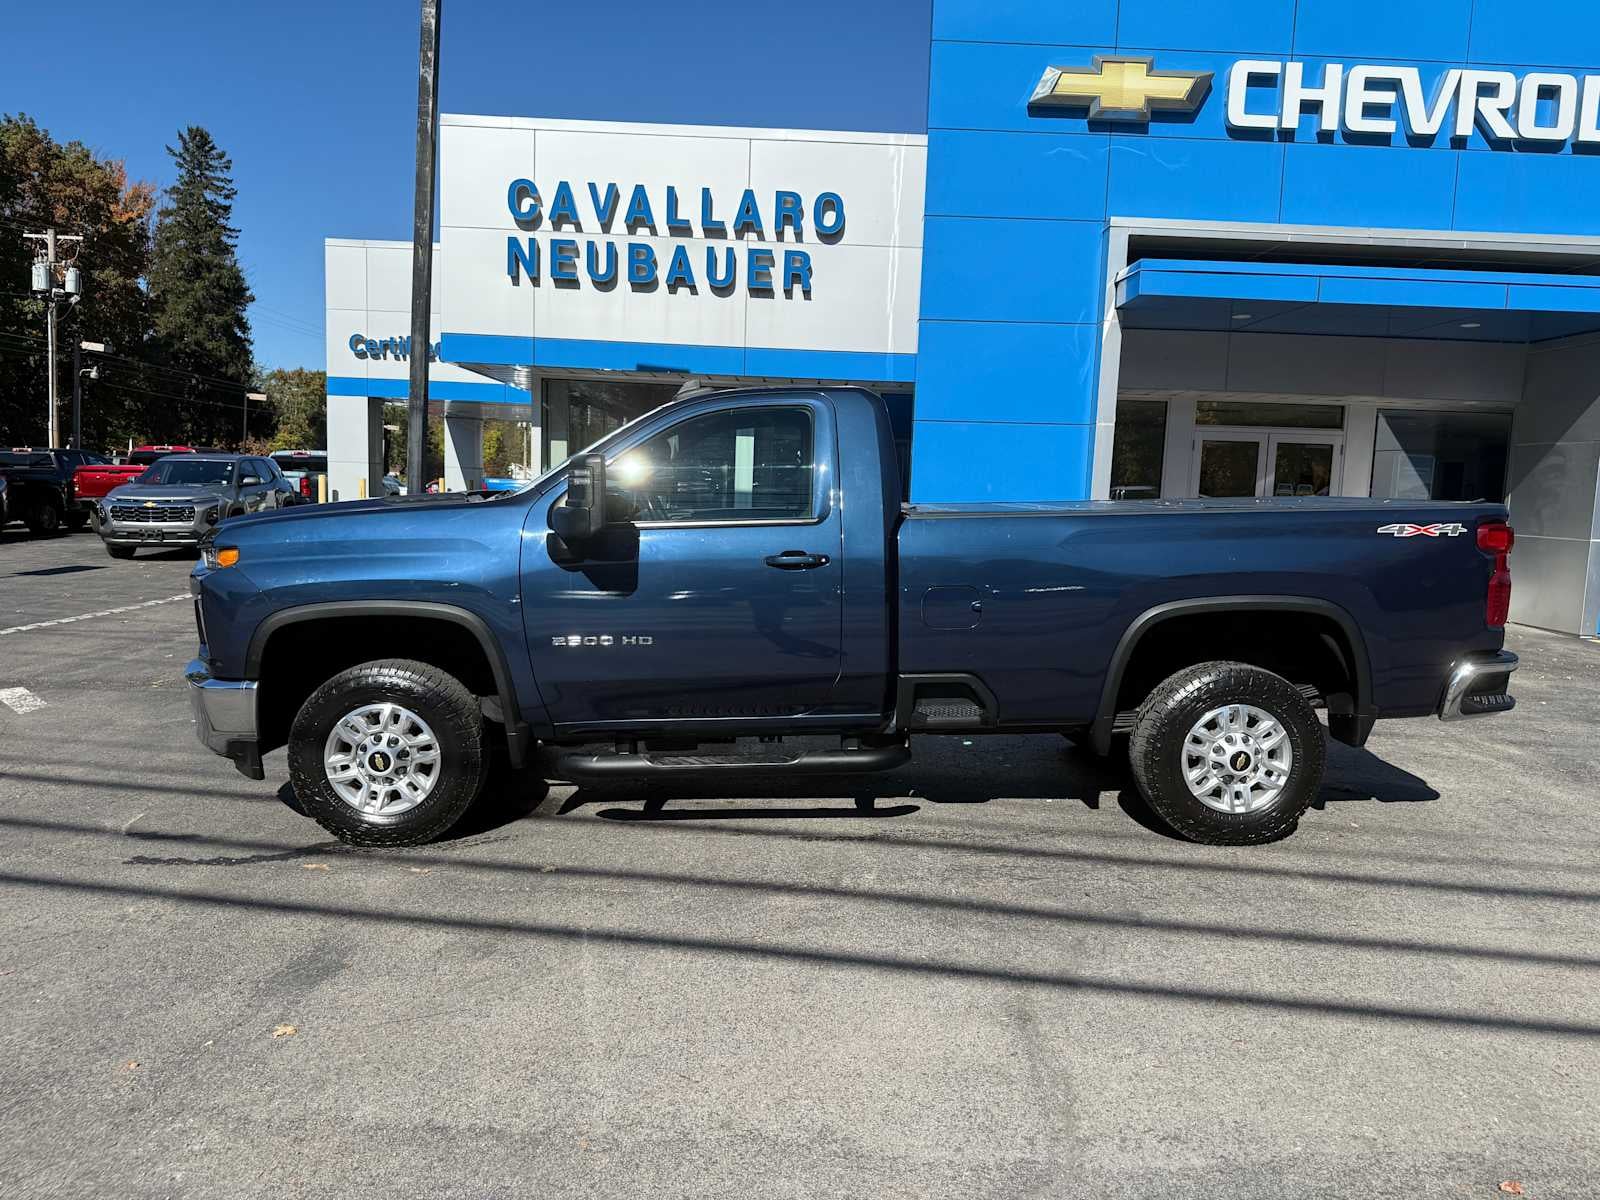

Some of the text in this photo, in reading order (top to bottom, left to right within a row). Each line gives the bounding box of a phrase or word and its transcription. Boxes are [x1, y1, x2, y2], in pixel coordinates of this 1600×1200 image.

[507, 178, 846, 244] CAVALLARO
[507, 236, 812, 299] NEUBAUER
[622, 636, 653, 645] HD
